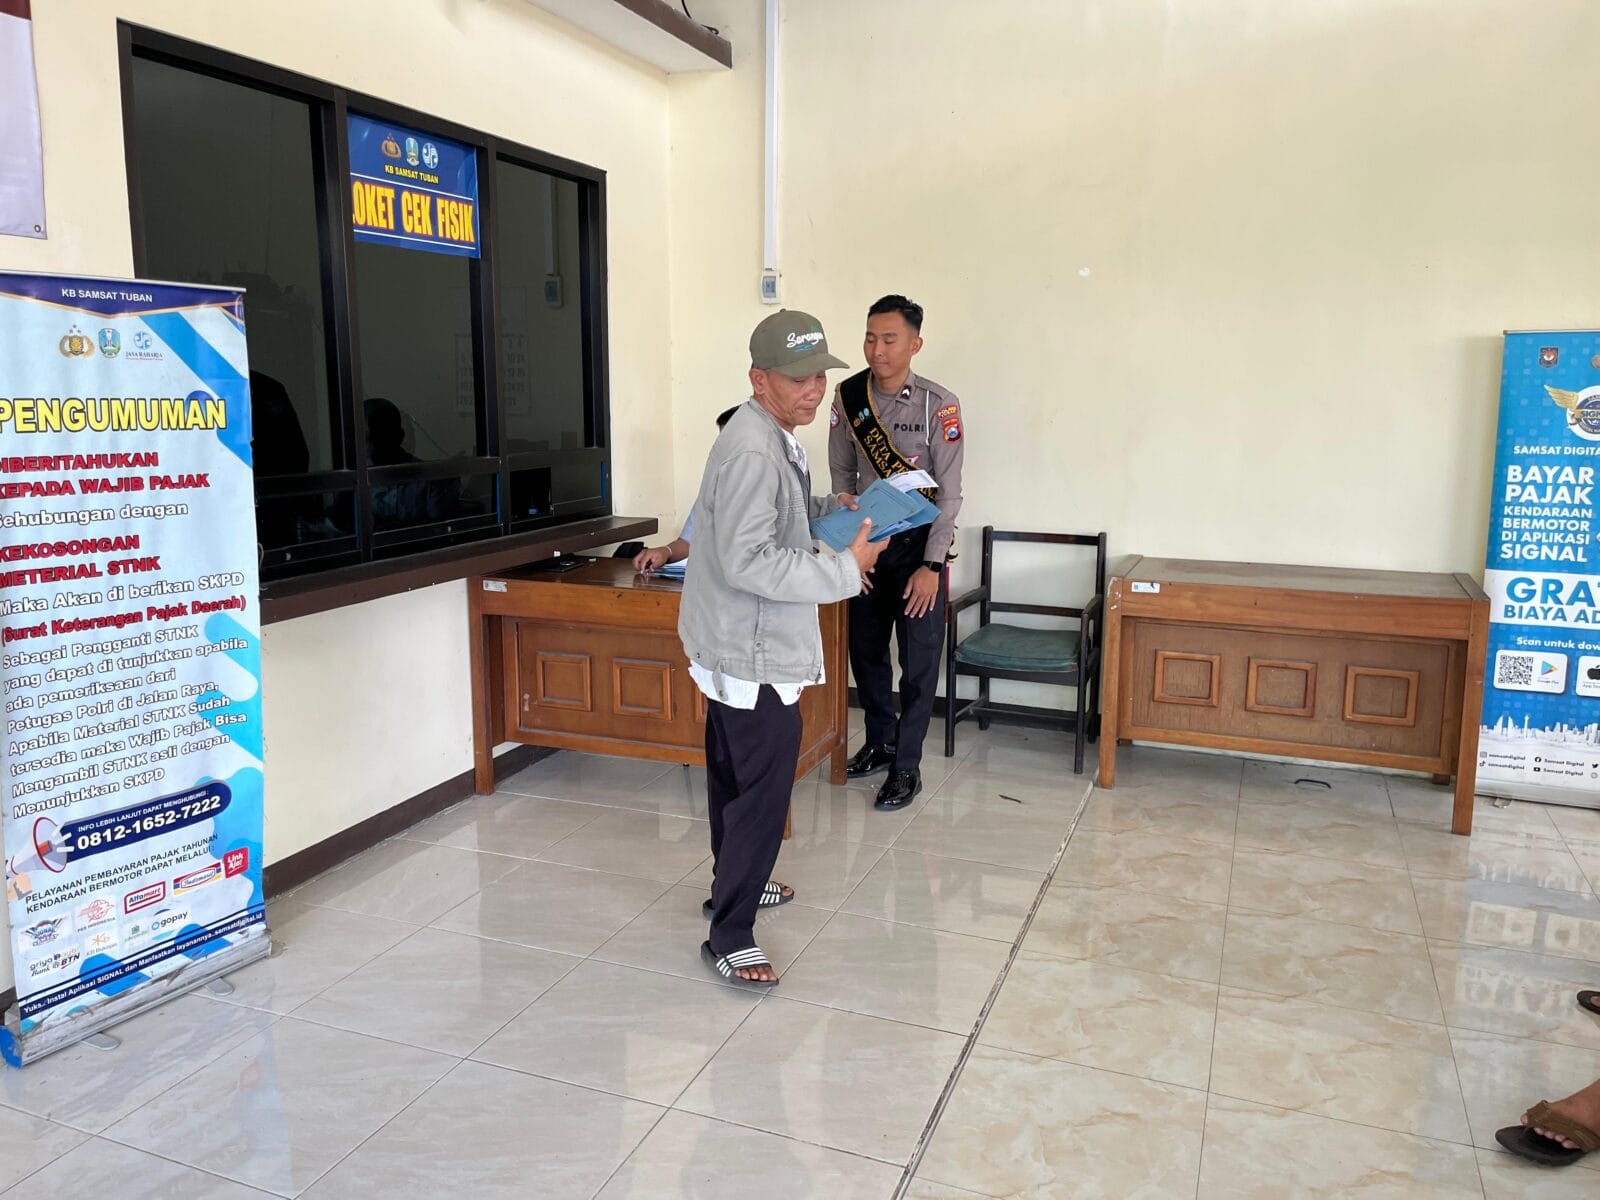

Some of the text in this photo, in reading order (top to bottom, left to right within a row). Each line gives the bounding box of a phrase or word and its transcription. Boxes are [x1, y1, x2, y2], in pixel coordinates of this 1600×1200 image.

[385, 164, 438, 184] KB SAMSAT TUBAN
[352, 180, 475, 243] OKET CEK FISIK
[62, 288, 153, 303] KB SAMSAT TUBAN
[0, 398, 228, 433] PENGUMUMAN
[894, 423, 924, 432] POLRI
[864, 434, 892, 478] SAMSA
[870, 427, 892, 461] DUTA
[1513, 445, 1600, 456] SAMSAT DIGITA
[0, 452, 158, 474] IBERITAHUKAN
[1506, 464, 1594, 486] BAYAR
[80, 476, 144, 495] WAJIB
[150, 474, 210, 490] PAJAK
[1504, 484, 1593, 505] PAJAK
[120, 503, 188, 519] dengan
[1502, 518, 1590, 532] BERMOTOR
[1503, 506, 1592, 519] KENDARAAN
[1500, 544, 1588, 562] SIGNAL
[1501, 530, 1590, 545] DI APLIKASI
[107, 556, 161, 576] STNK
[0, 572, 244, 617] Maka Akan di berikan SKPD
[1506, 576, 1600, 608] GRA
[52, 611, 144, 636] Keterangan
[146, 600, 188, 622] Pajak
[192, 595, 247, 614] Daerah)
[1504, 604, 1600, 624] BIAYA AD
[3, 625, 199, 670] Sebagai Pengganti STNK
[1516, 636, 1542, 646] Scan
[1544, 640, 1575, 649] untuk
[4, 637, 248, 694] yang dapat di tunjukkan apabila
[5, 668, 176, 714] ada pemeriksaan dari
[7, 680, 220, 734] Petugas Polri di Jalan Raya,
[8, 696, 231, 756] Apabila Material STNK Sudah
[10, 712, 248, 777] tersedia maka Wajib Pajak Bisa
[12, 734, 231, 798] Mengambil STNK asli dengan
[13, 768, 166, 819] Menunjukkan SKPD
[77, 794, 221, 851] 0812-1652-7222
[78, 822, 95, 834] INFO
[96, 816, 116, 829] LEBIH
[116, 810, 142, 825] LANJUT
[143, 803, 162, 815] DAPAT
[26, 833, 218, 904] PELAYANAN PEMBAYARAN PAJAK TAHUNAN
[26, 889, 88, 914] KENDARAAN
[89, 869, 143, 893] BERMOTOR
[144, 860, 174, 876] DAPAT
[128, 887, 161, 904] Alfamart
[160, 911, 188, 928] gopay
[47, 989, 67, 1005] Instal
[68, 980, 96, 998] Aplikasi
[97, 968, 125, 985] SIGNAL
[124, 961, 138, 974] dan
[138, 945, 176, 967] Manfaatkan
